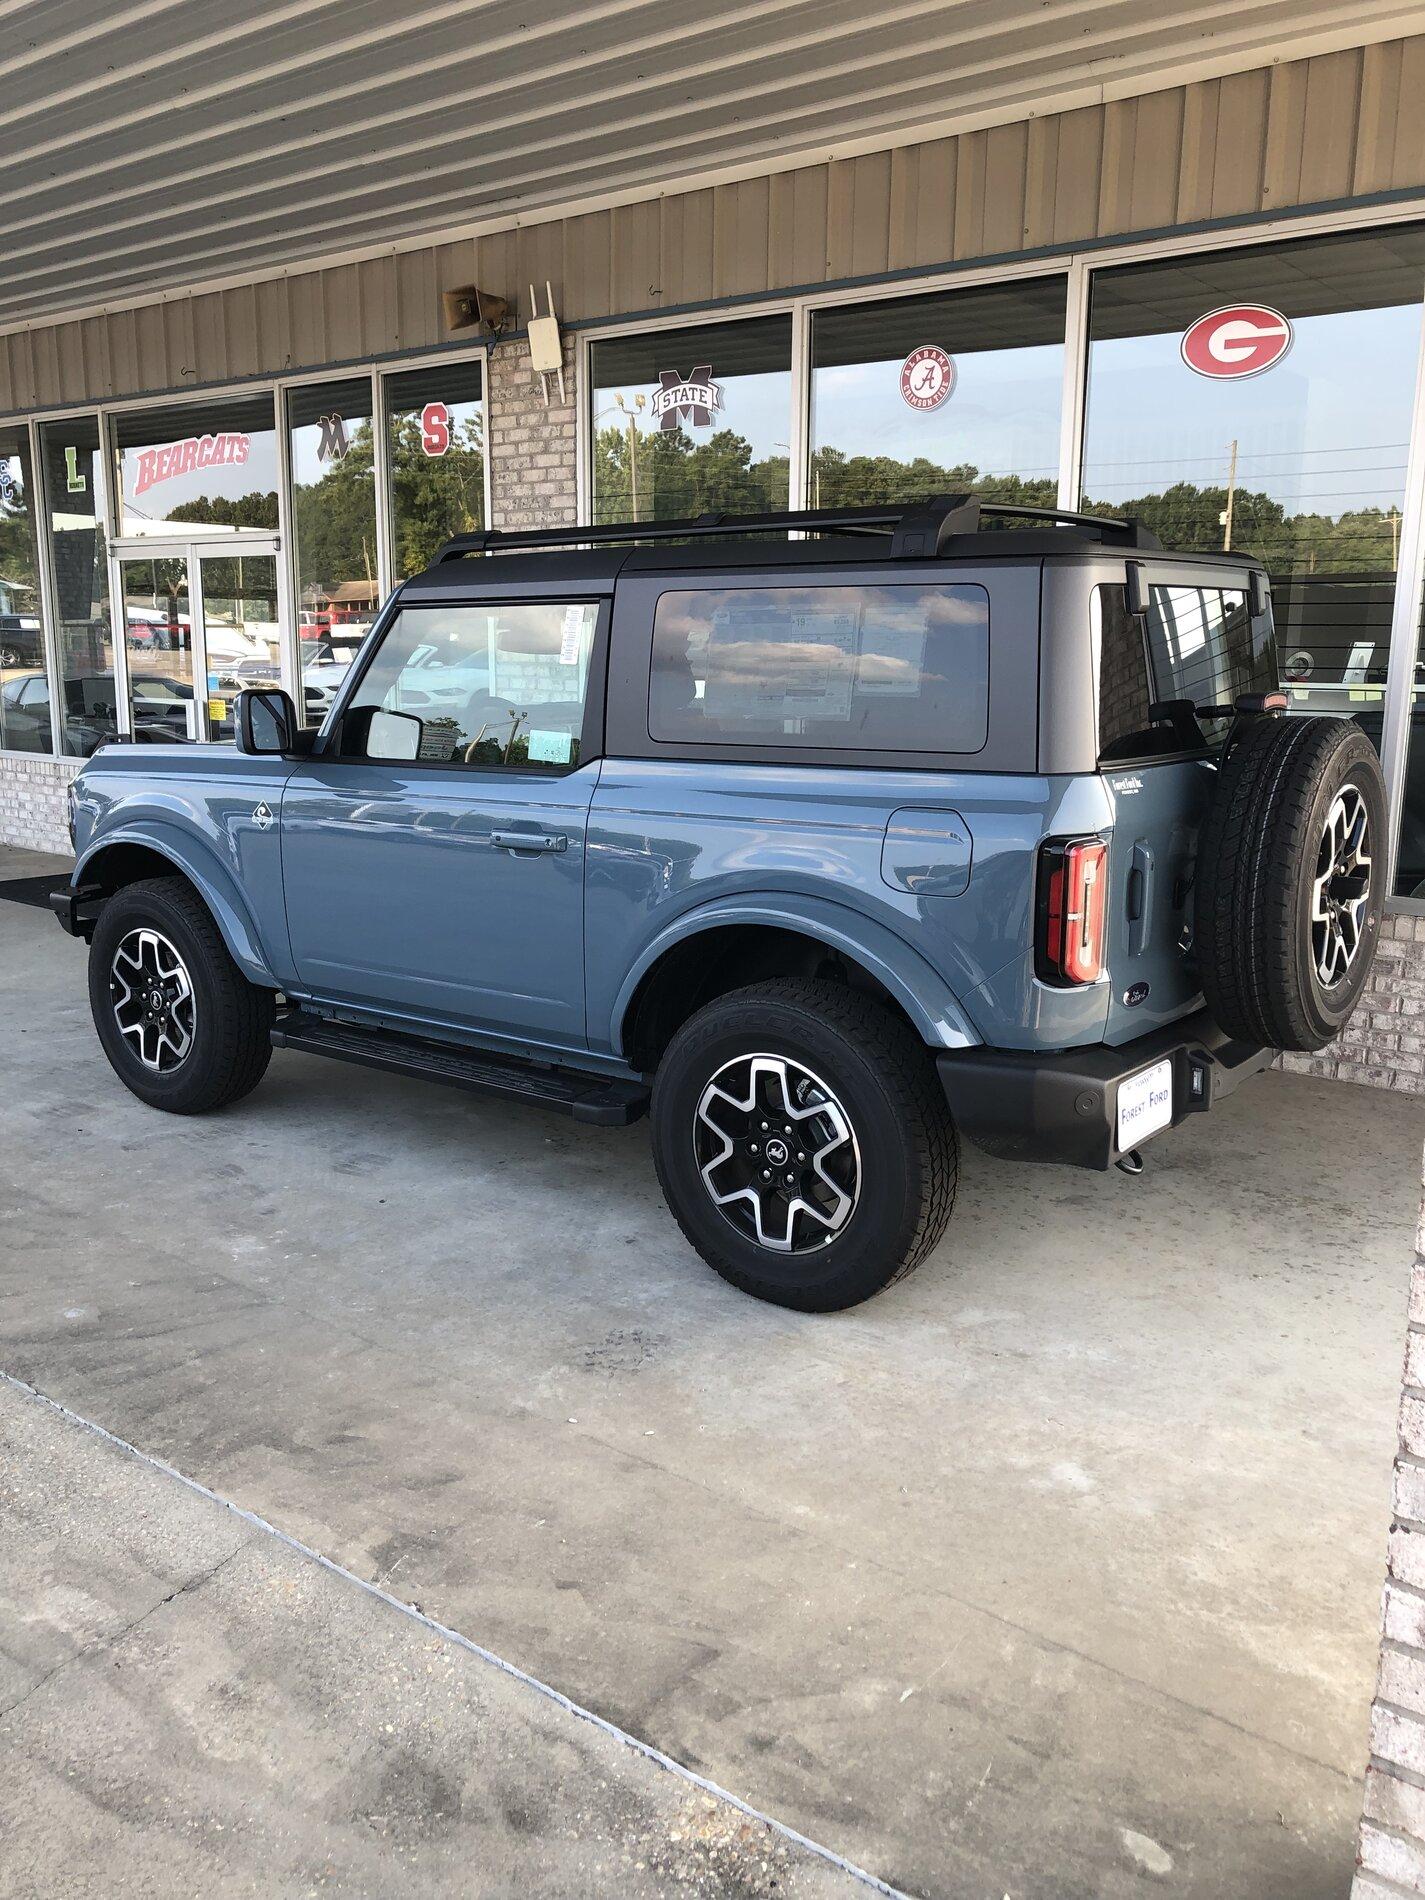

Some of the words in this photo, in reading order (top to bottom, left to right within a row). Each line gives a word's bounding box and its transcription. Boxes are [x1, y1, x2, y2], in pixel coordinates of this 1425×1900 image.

[1185, 308, 1286, 375] G
[904, 350, 949, 376] ALABAMA
[914, 365, 936, 391] A
[663, 387, 708, 408] STATE
[903, 384, 934, 407] CRIMSON
[933, 381, 949, 402] TIDE
[422, 403, 449, 456] S
[65, 447, 86, 492] L
[134, 434, 250, 496] BEARCATS
[1121, 1102, 1145, 1125] FOREST
[1149, 1089, 1169, 1108] FORD
